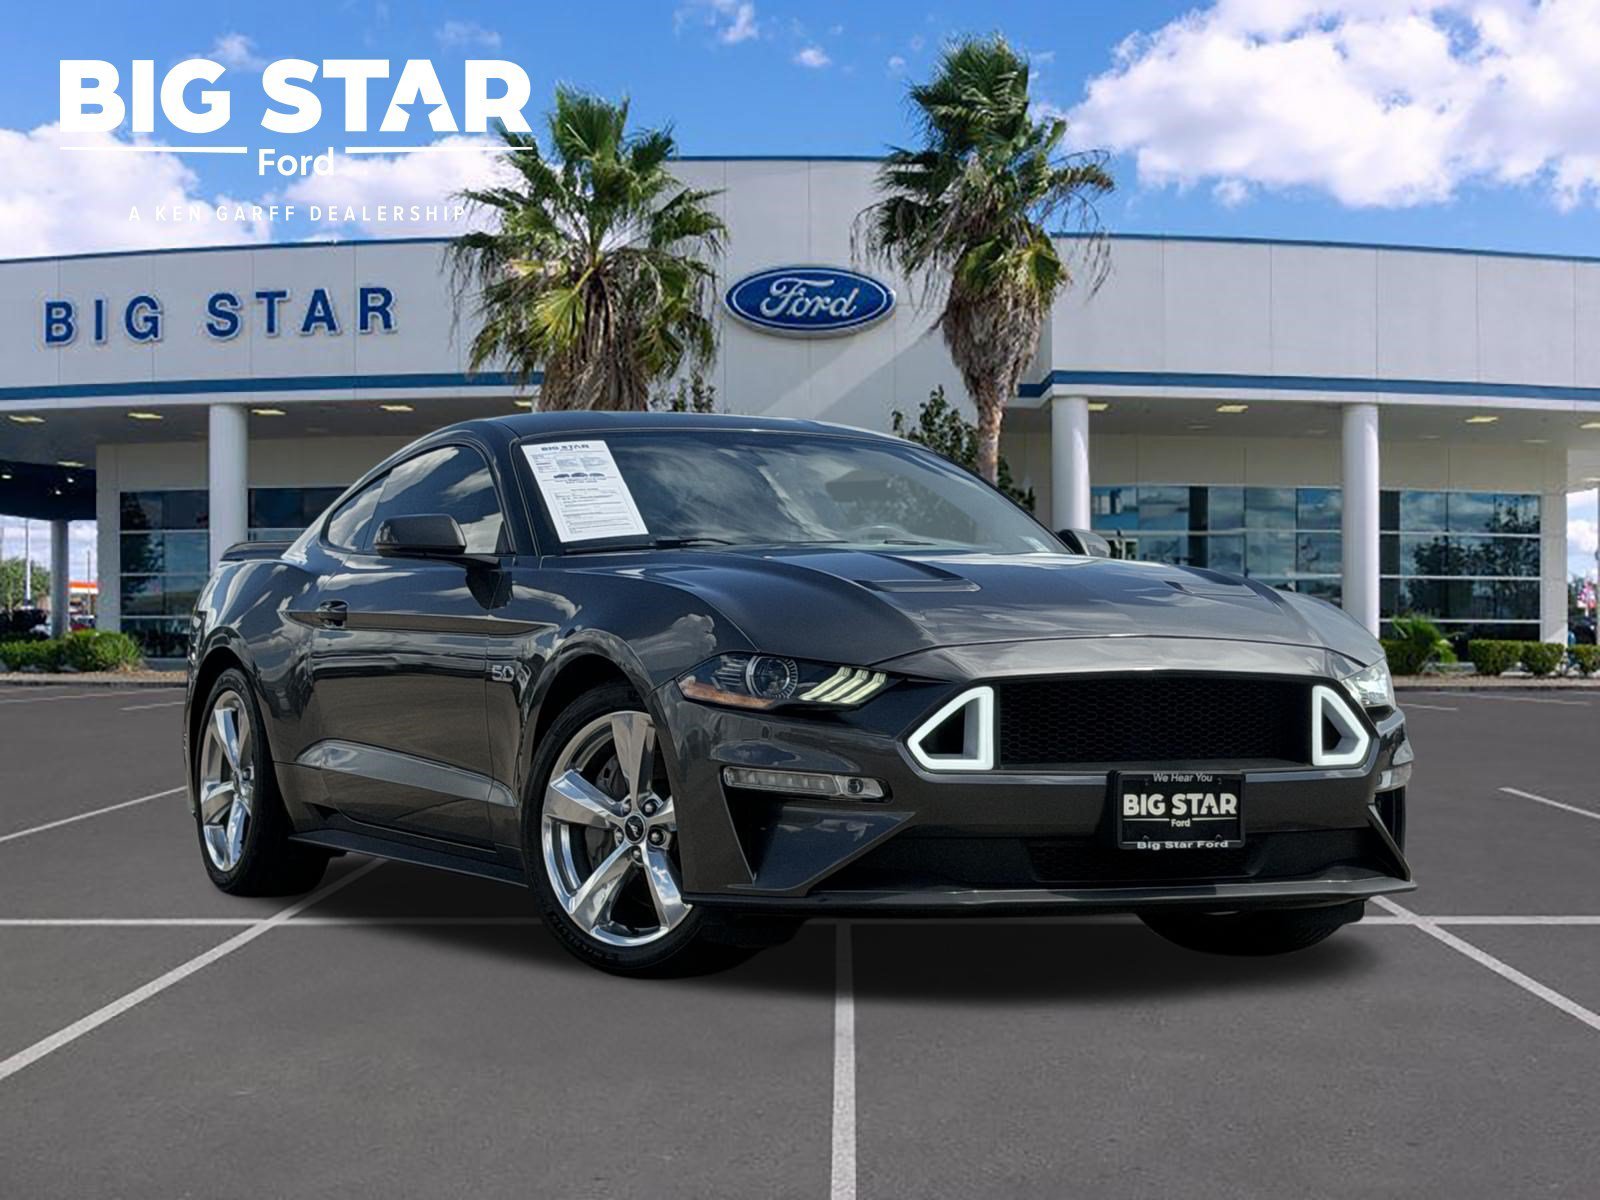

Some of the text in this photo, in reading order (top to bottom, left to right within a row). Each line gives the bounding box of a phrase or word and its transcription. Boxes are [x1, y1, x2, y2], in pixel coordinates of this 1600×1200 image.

[760, 277, 859, 317] Ford
[44, 286, 398, 345] BIG STAR
[1153, 772, 1213, 784] We Hear You
[1123, 793, 1237, 816] BIG STAR
[1171, 818, 1191, 828] Ford
[1137, 840, 1229, 851] Big Star Ford
